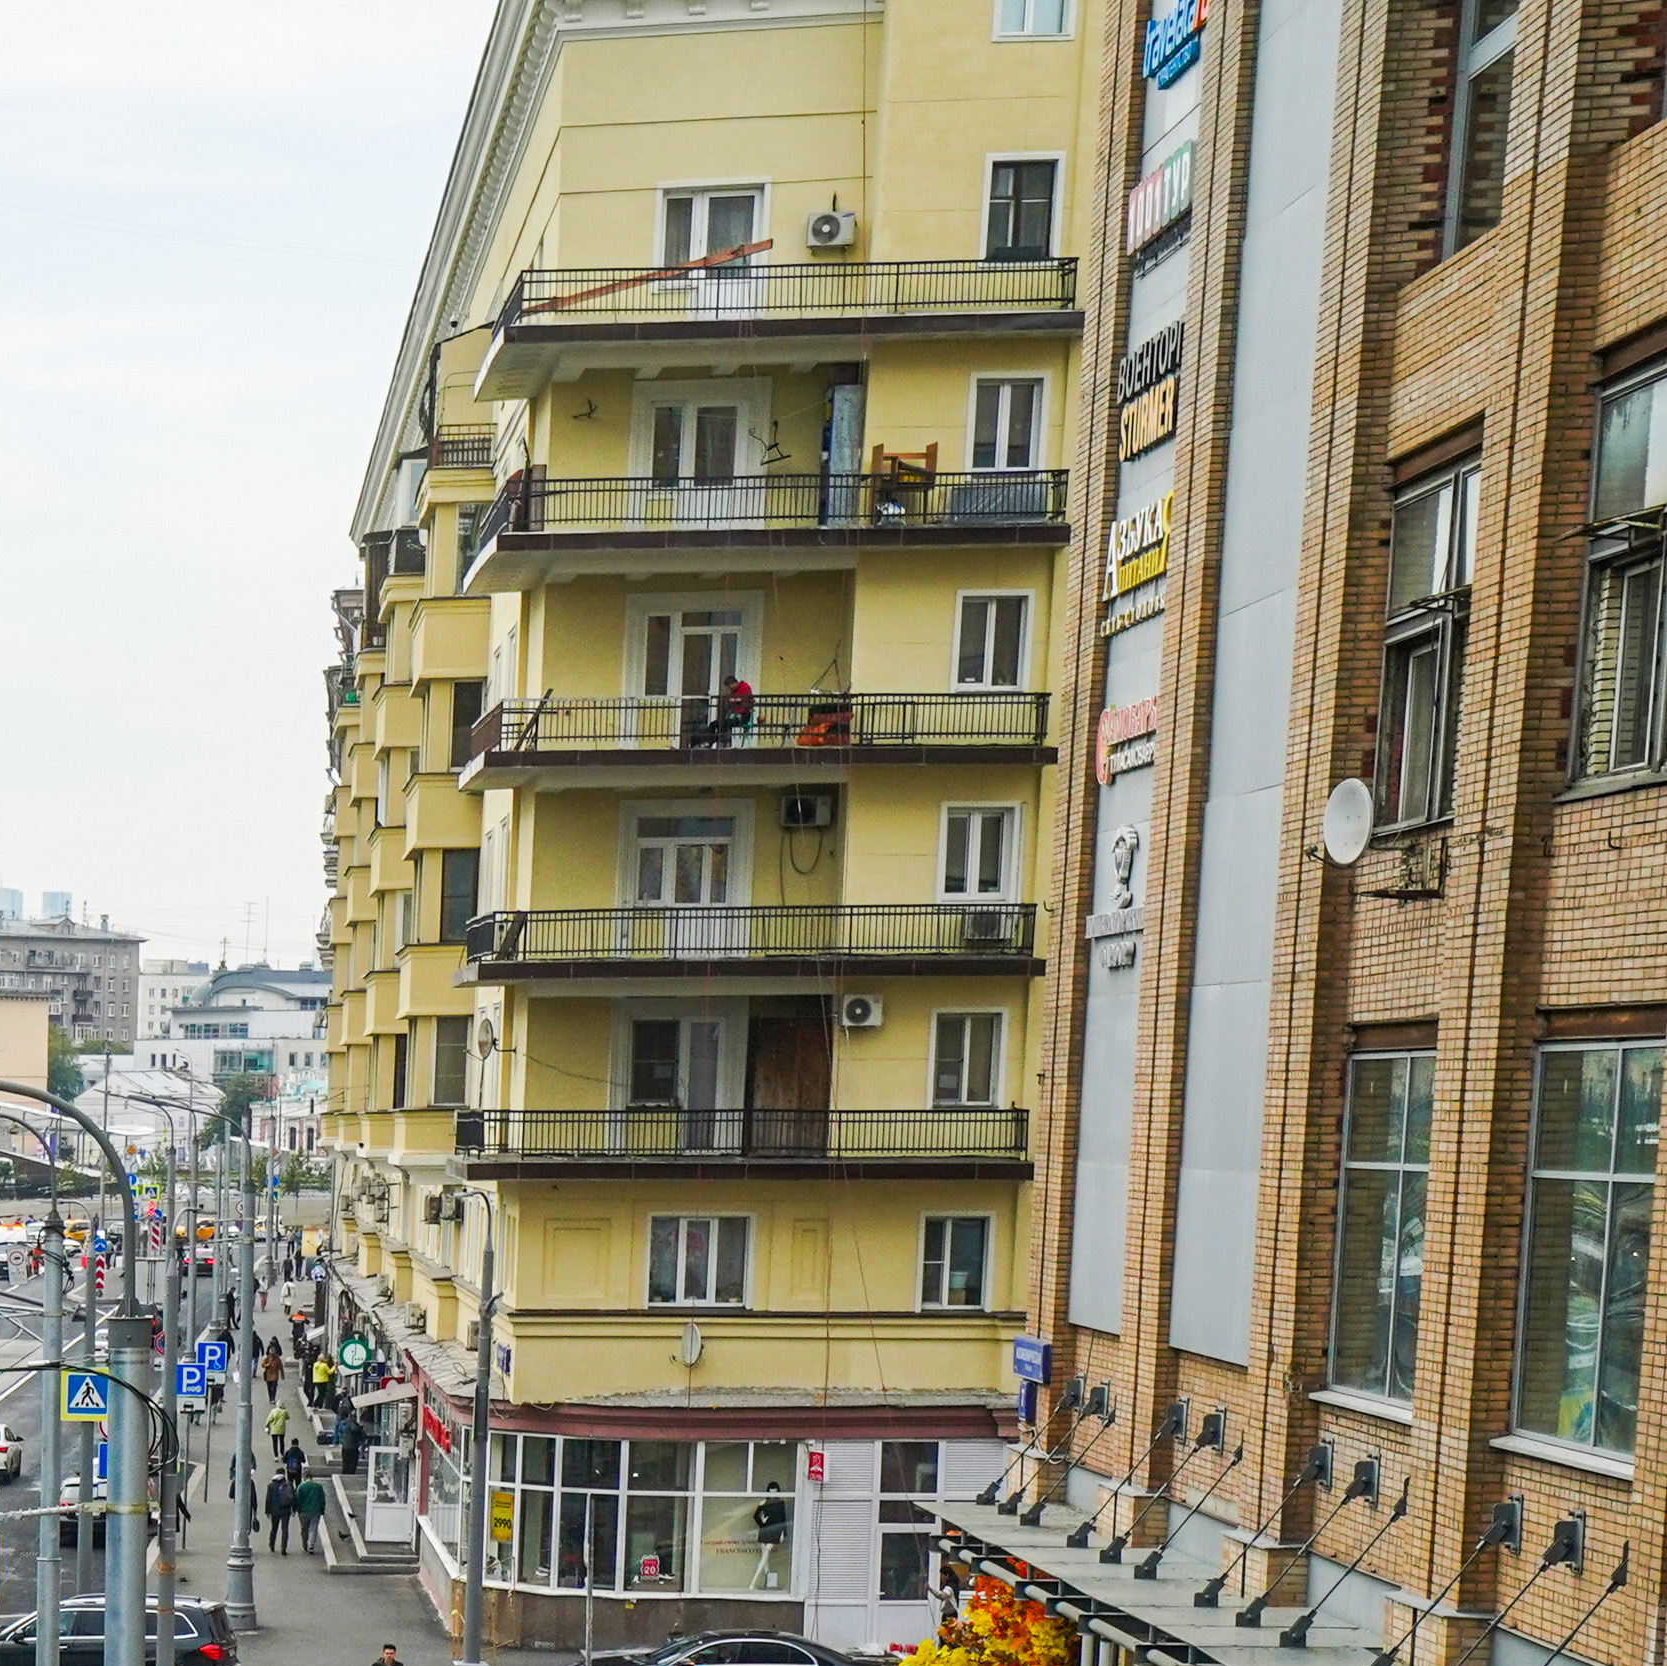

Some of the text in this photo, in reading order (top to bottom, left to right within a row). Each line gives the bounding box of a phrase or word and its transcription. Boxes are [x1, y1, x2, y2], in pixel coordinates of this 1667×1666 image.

[1119, 376, 1175, 462] STURMER
[1102, 499, 1164, 602] АЗБУКА
[494, 1517, 512, 1529] 2990
[644, 1566, 656, 1575] 20
